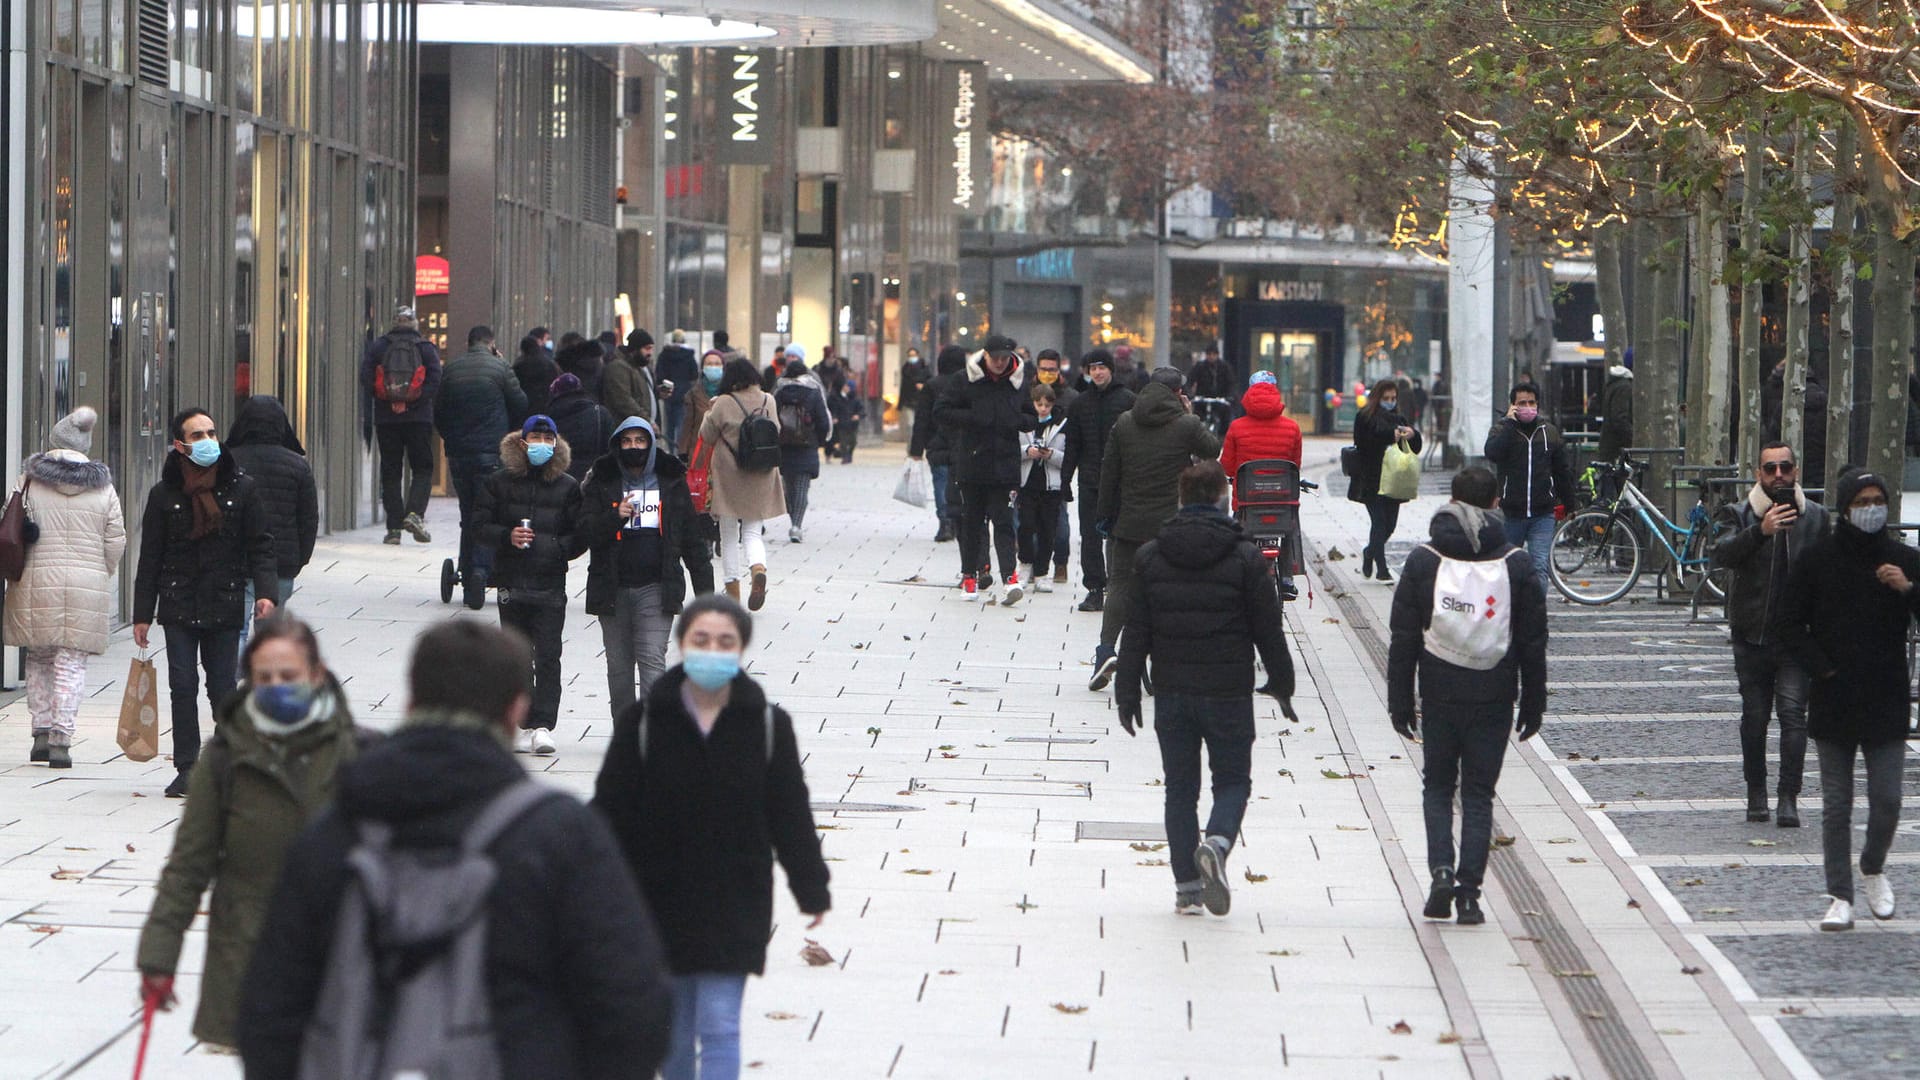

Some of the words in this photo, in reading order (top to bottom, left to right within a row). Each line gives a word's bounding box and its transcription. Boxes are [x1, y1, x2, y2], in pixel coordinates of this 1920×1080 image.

[732, 46, 759, 141] MAN
[1259, 281, 1323, 300] KARSTADT
[1441, 596, 1475, 613] Slam
